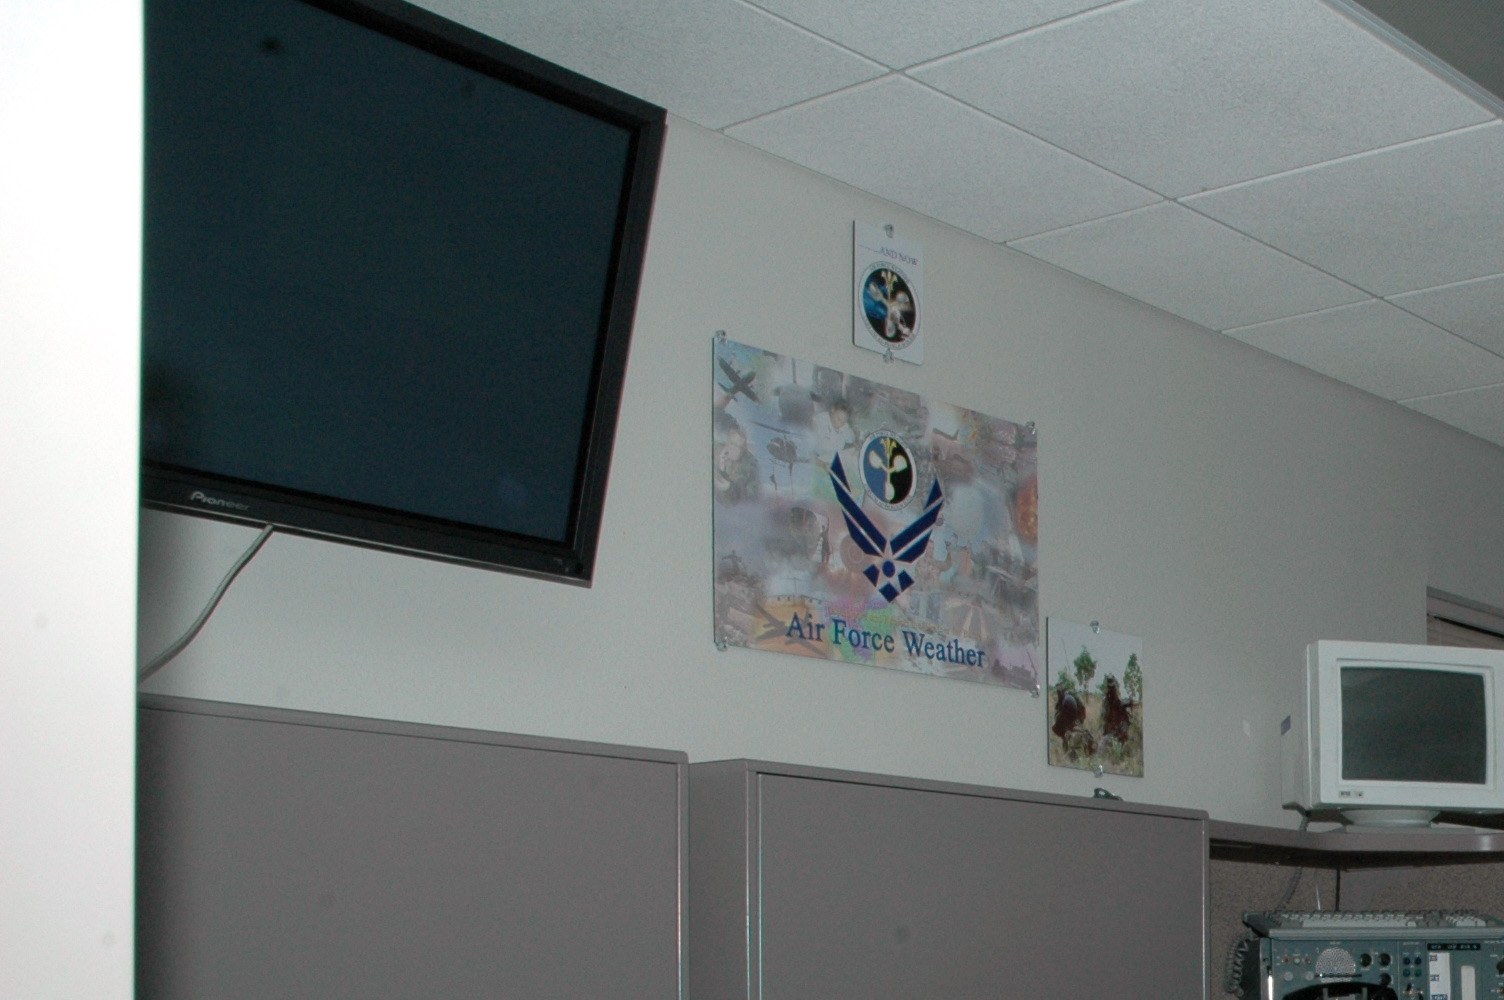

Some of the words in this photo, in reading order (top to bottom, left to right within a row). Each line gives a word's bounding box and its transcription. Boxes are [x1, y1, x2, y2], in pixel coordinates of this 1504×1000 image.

[190, 490, 249, 511] Pioneer
[786, 612, 826, 643] Air
[832, 618, 896, 654] Force
[902, 630, 986, 668] Weather
